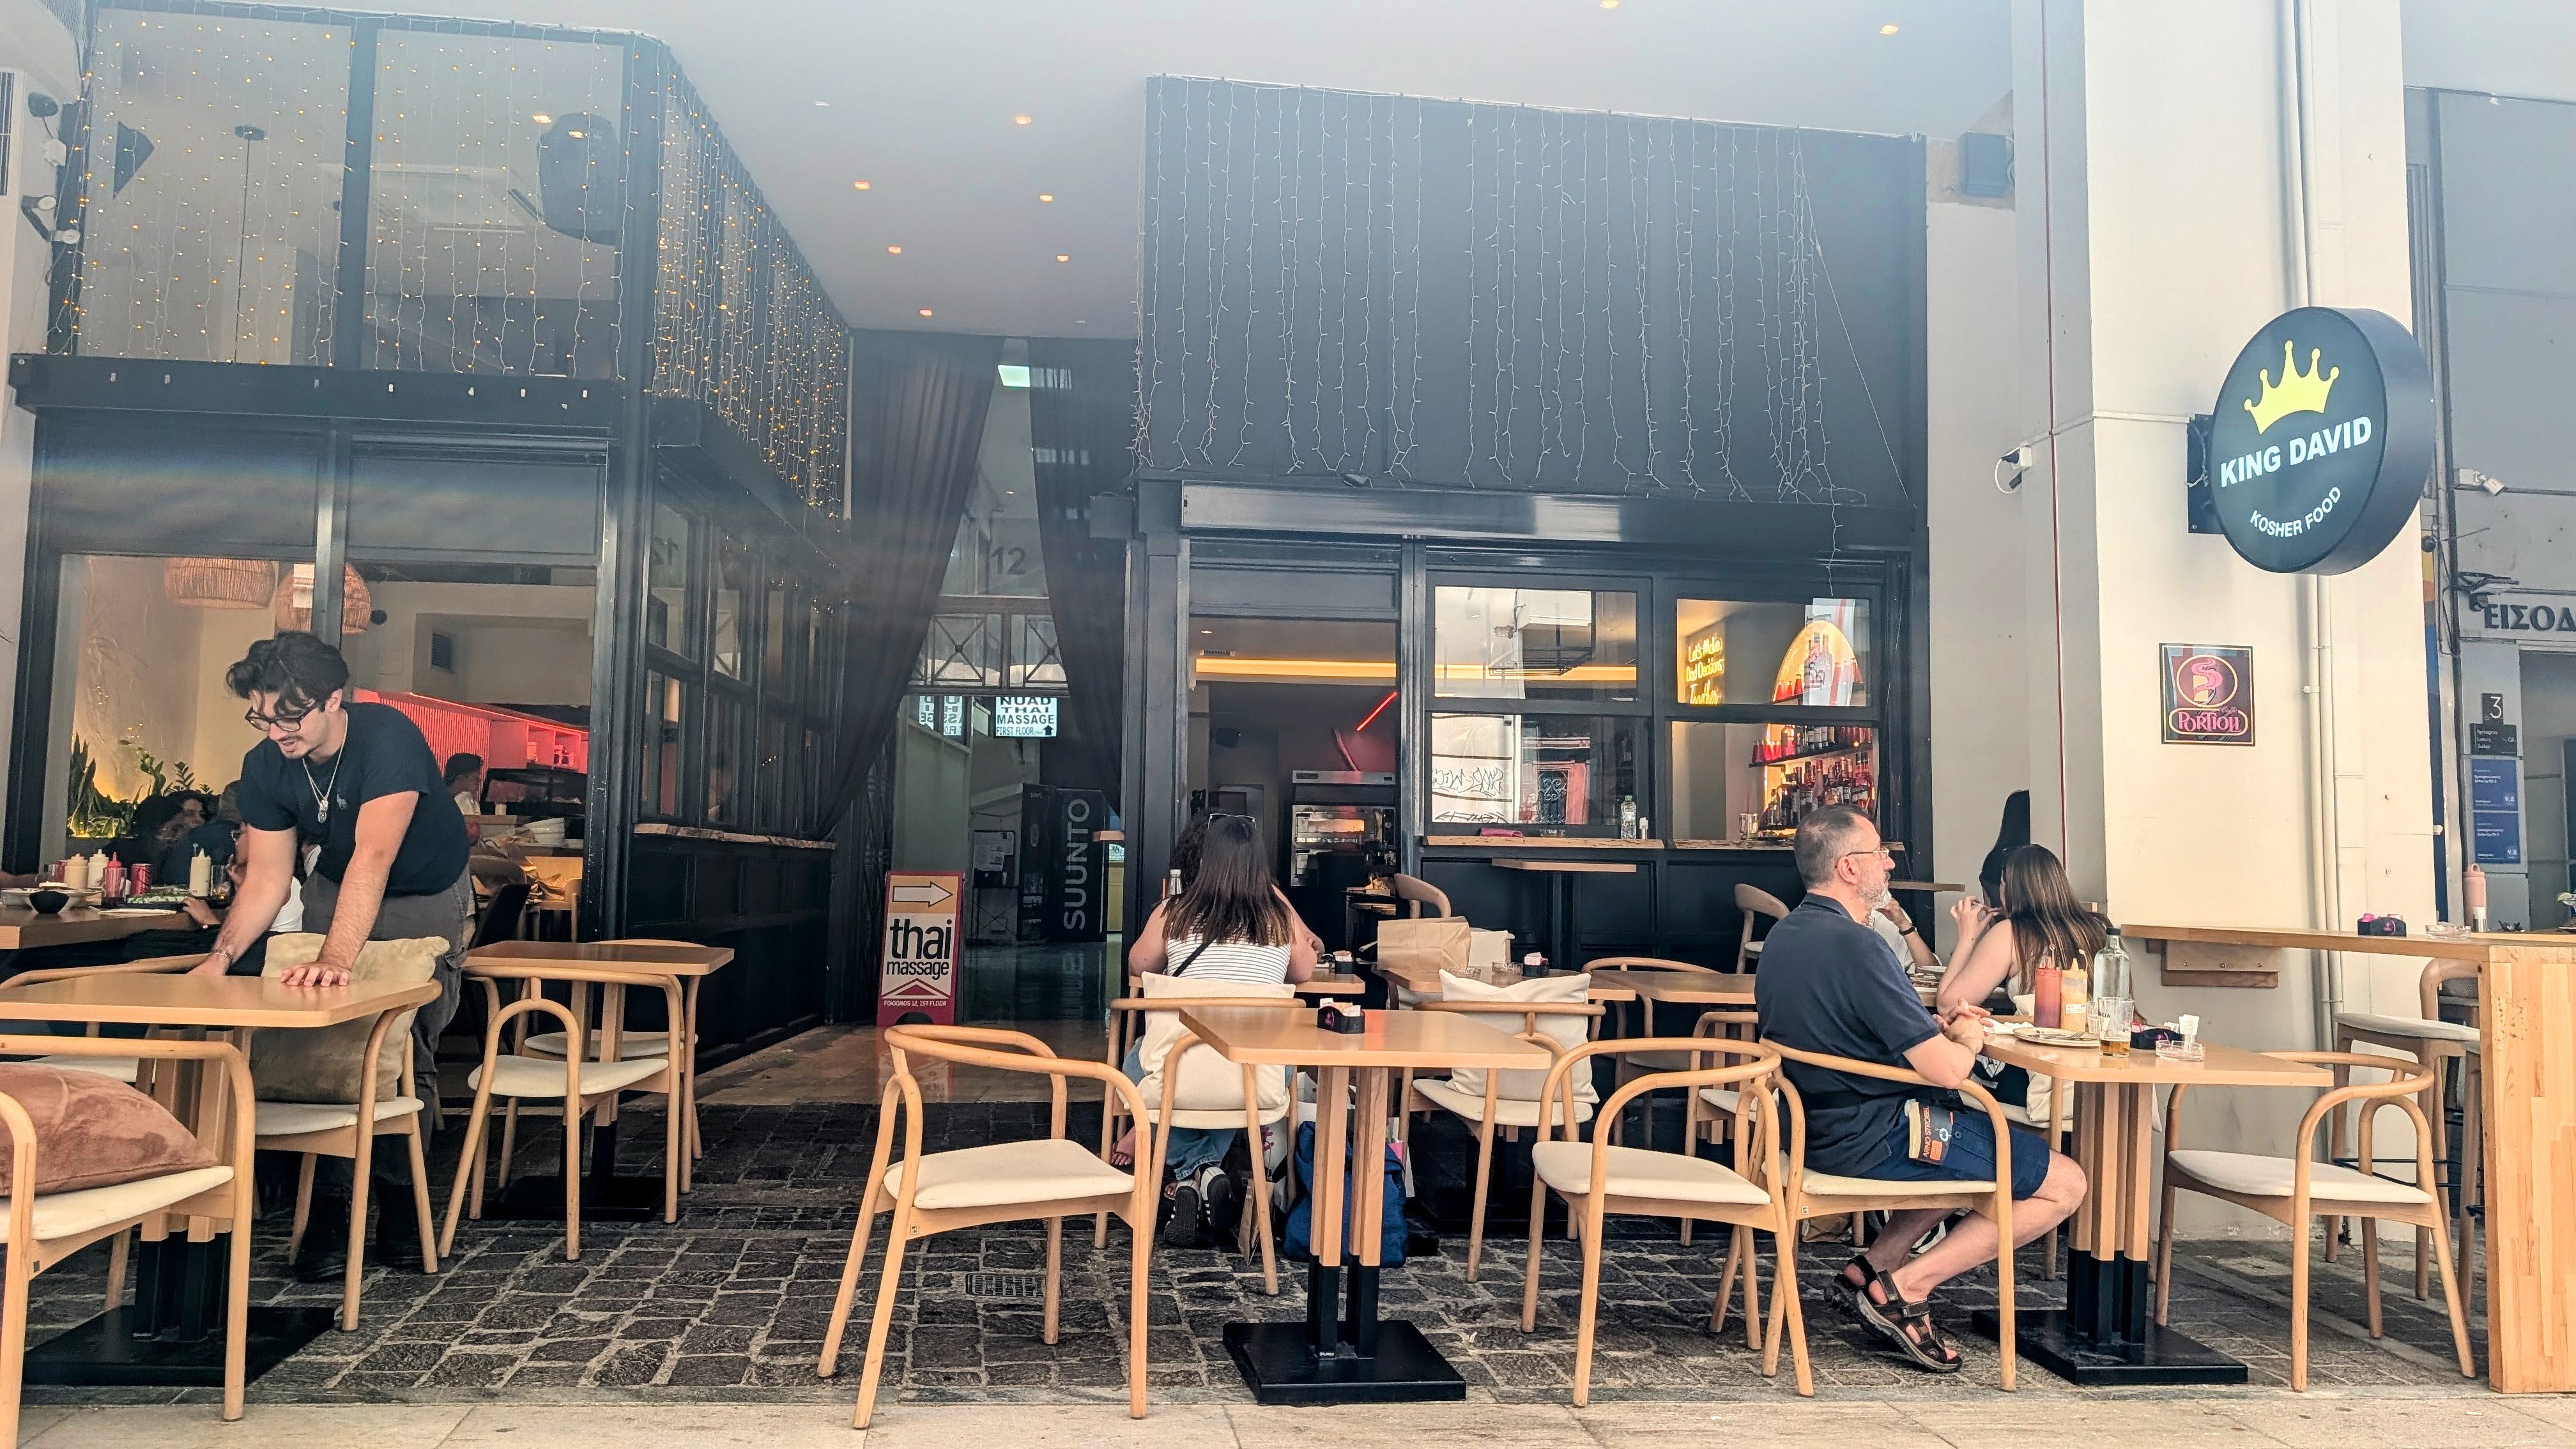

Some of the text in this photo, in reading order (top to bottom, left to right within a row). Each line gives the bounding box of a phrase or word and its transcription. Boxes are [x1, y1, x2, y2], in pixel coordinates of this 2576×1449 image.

[2221, 416, 2372, 487] KING DAVID
[2250, 487, 2342, 537] KOSHER FOOD
[990, 546, 1027, 575] 12
[1000, 696, 1051, 705] NUAD
[2490, 696, 2502, 719] 3
[996, 726, 1015, 735] FIRST
[1015, 726, 1034, 735] FLOOR
[997, 714, 1054, 724] MASSAGE
[1063, 799, 1090, 930] SUUNTO
[889, 918, 953, 960] thai
[885, 961, 949, 980] massage
[1923, 1136, 1931, 1158] ARNO
